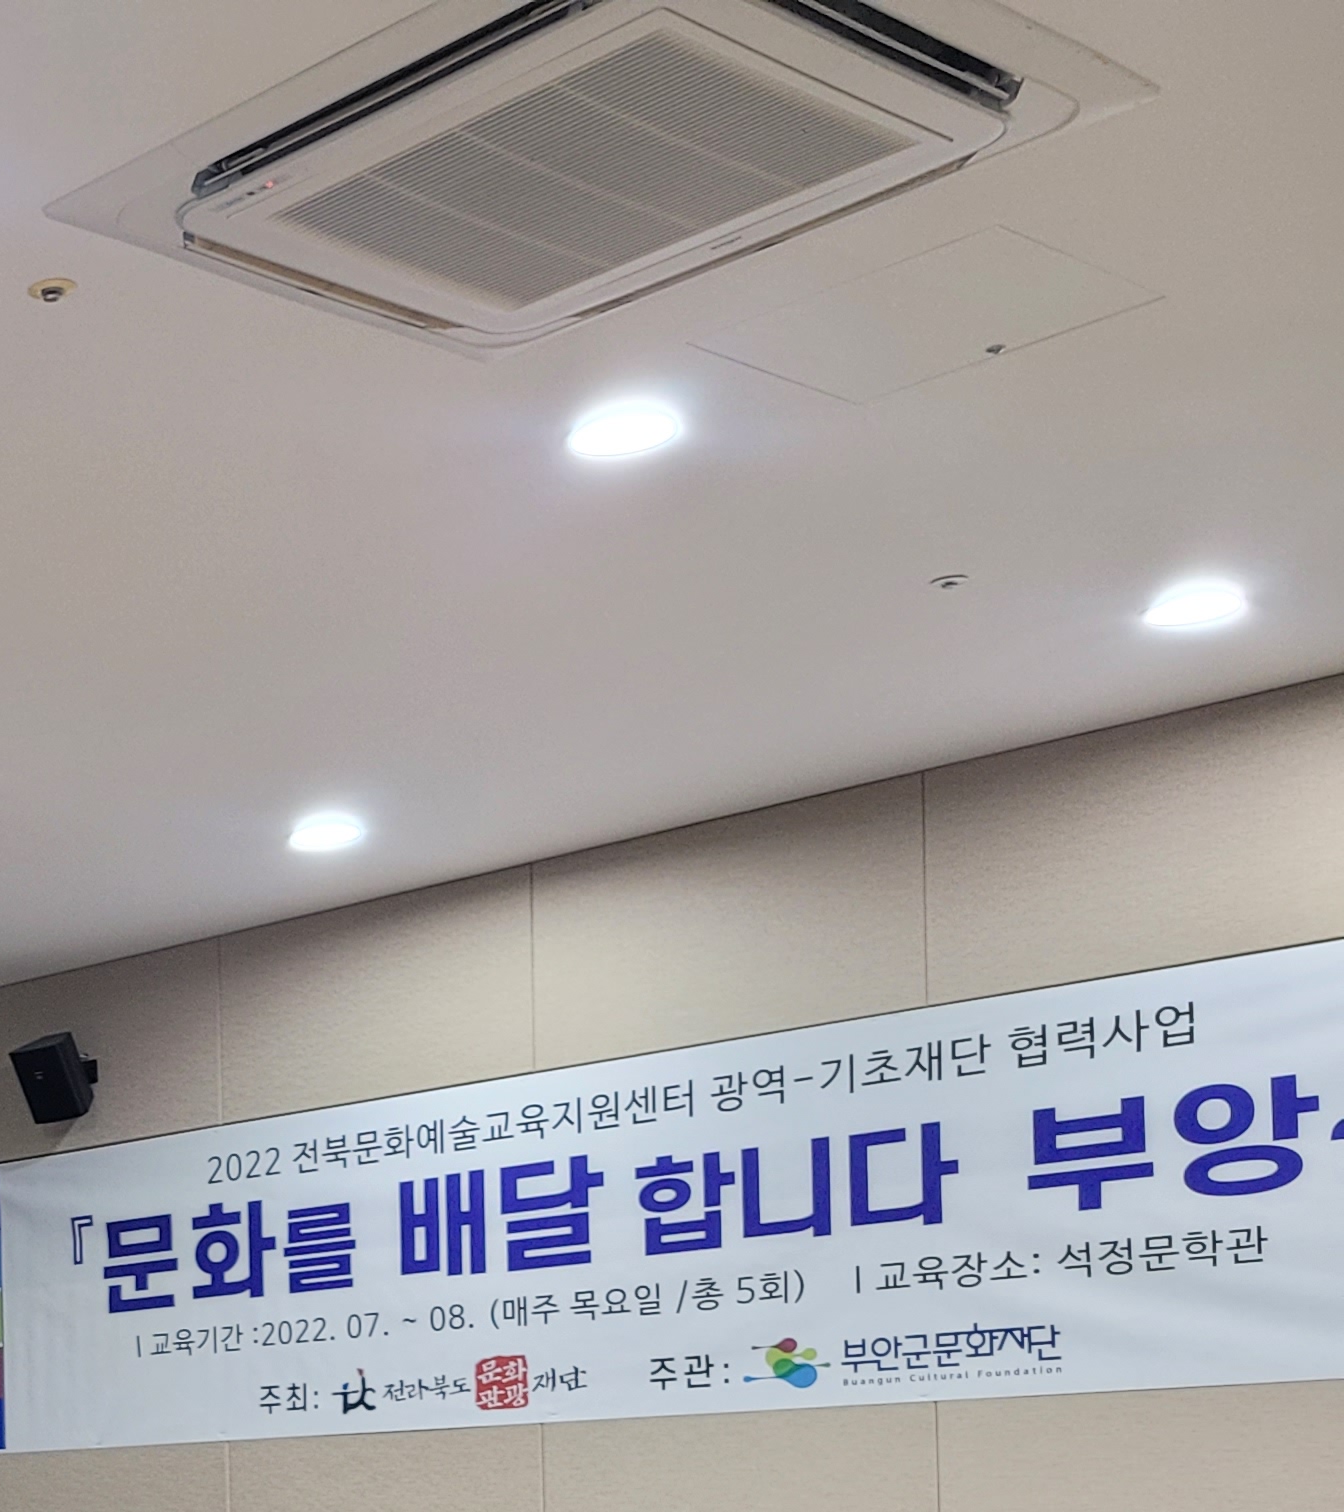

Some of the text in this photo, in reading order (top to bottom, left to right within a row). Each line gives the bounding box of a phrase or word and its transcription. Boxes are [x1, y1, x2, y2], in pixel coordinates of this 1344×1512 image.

[207, 1001, 1197, 1184] 2022 전북문화예술교육지원센터 광역-기초재단 협력사업
[398, 1154, 604, 1277] 배달
[634, 1121, 959, 1256] 합니다
[1027, 1073, 1344, 1211] 부앙
[489, 1293, 561, 1331] (매주
[569, 1280, 662, 1322] 목요일
[735, 1268, 806, 1309] 5회)
[1056, 1224, 1269, 1280] 석정문학관
[841, 1322, 1063, 1374] 부안군문화재단
[842, 1365, 1063, 1387] Buangun Cultural Foundation
